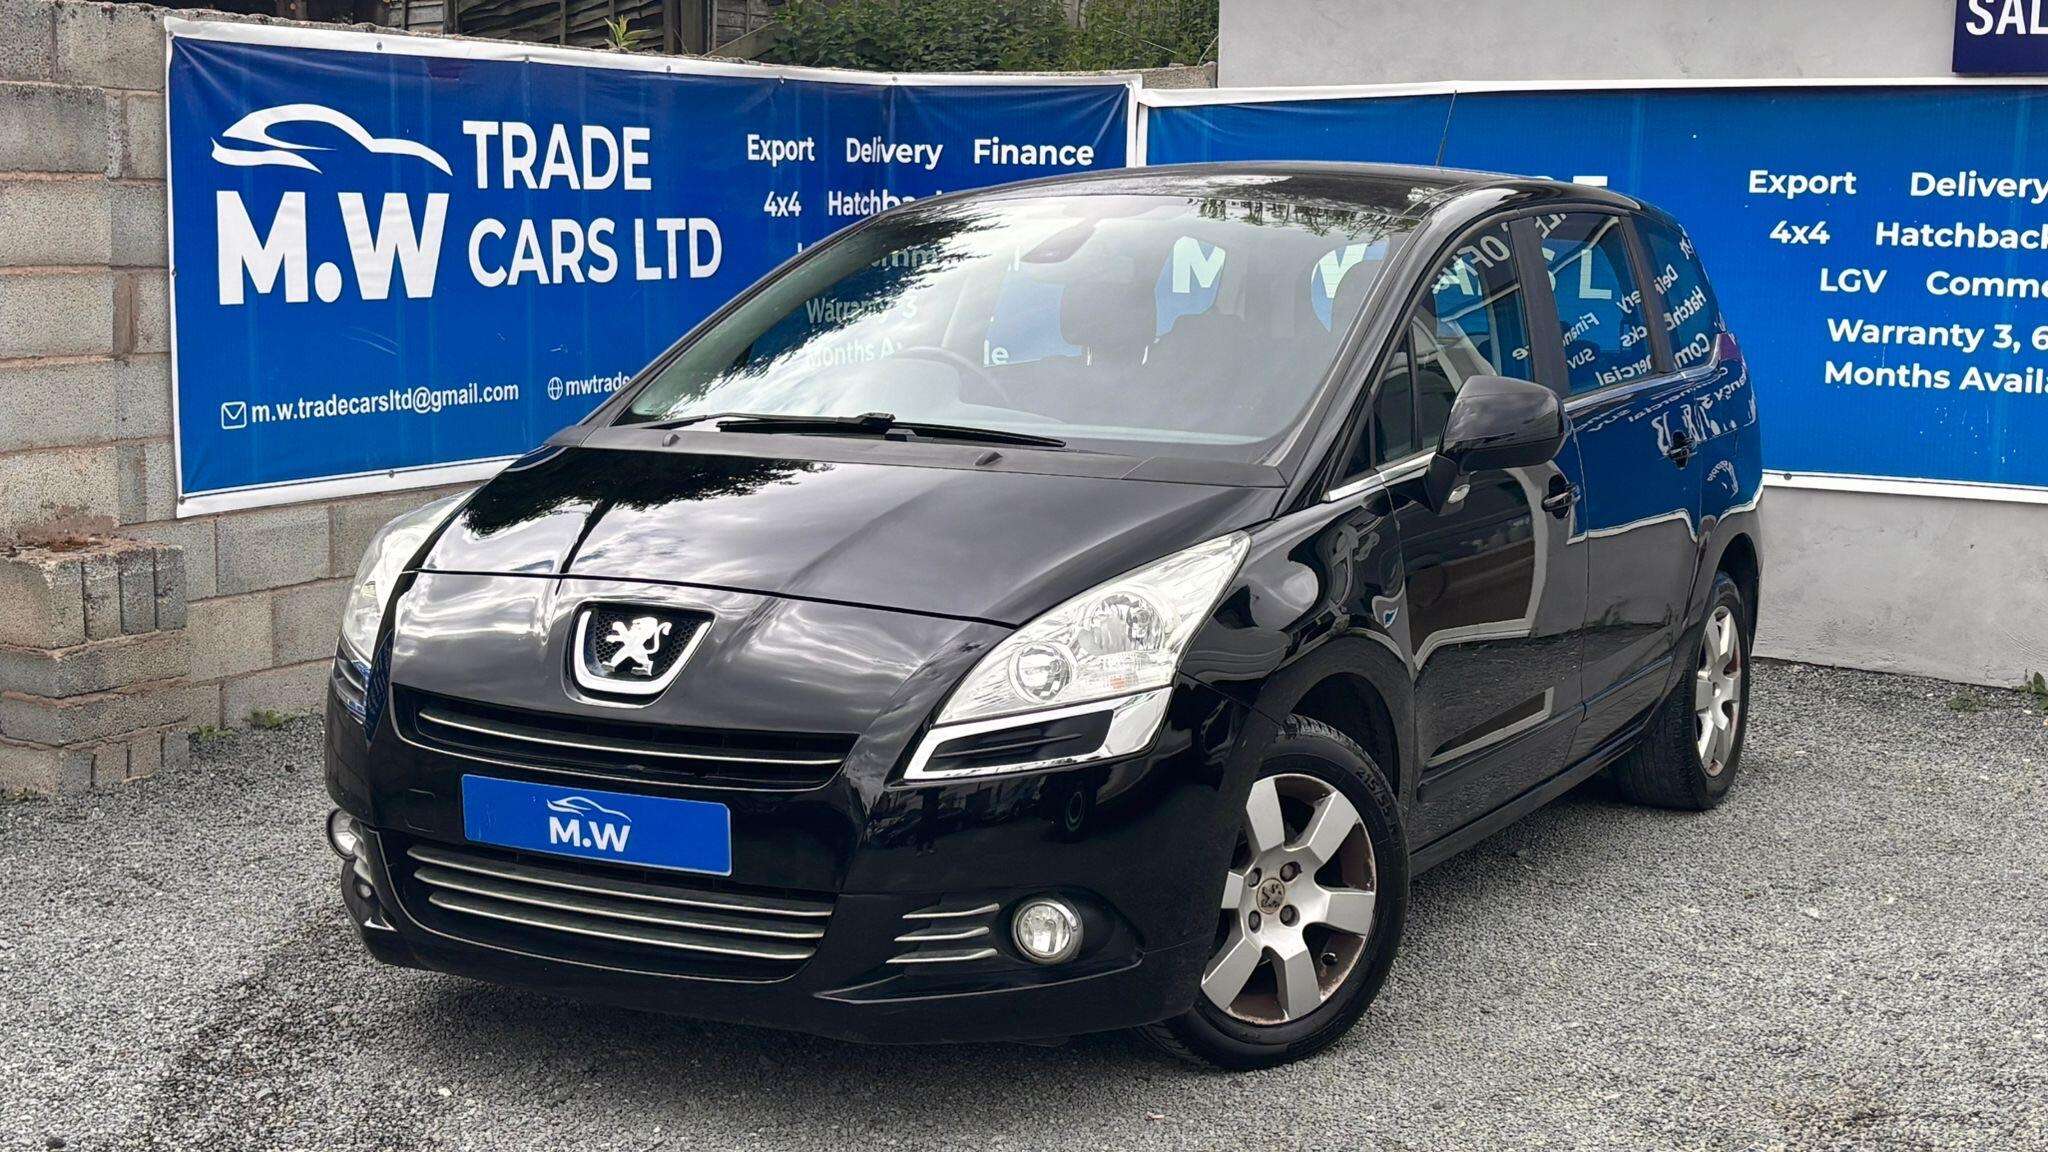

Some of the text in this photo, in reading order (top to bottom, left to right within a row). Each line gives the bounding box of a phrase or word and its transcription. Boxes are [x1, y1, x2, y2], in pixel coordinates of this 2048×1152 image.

[1966, 0, 2048, 36] SAL
[463, 120, 652, 191] TRADE
[747, 134, 1094, 170] Export Delivery Finance
[763, 190, 802, 218] 4x4
[1748, 169, 2048, 205] Export Delivery
[216, 190, 450, 305] M.W
[1769, 220, 1831, 245] 4x4
[468, 216, 723, 288] CARS LTD
[1819, 268, 1888, 293] LGV
[1827, 318, 1985, 353] Warranty
[1992, 324, 2021, 354] 3,
[1825, 361, 1950, 389] Months
[251, 382, 519, 423] m.w.tradecarsltd@gmail.com
[549, 815, 631, 852] M.W
